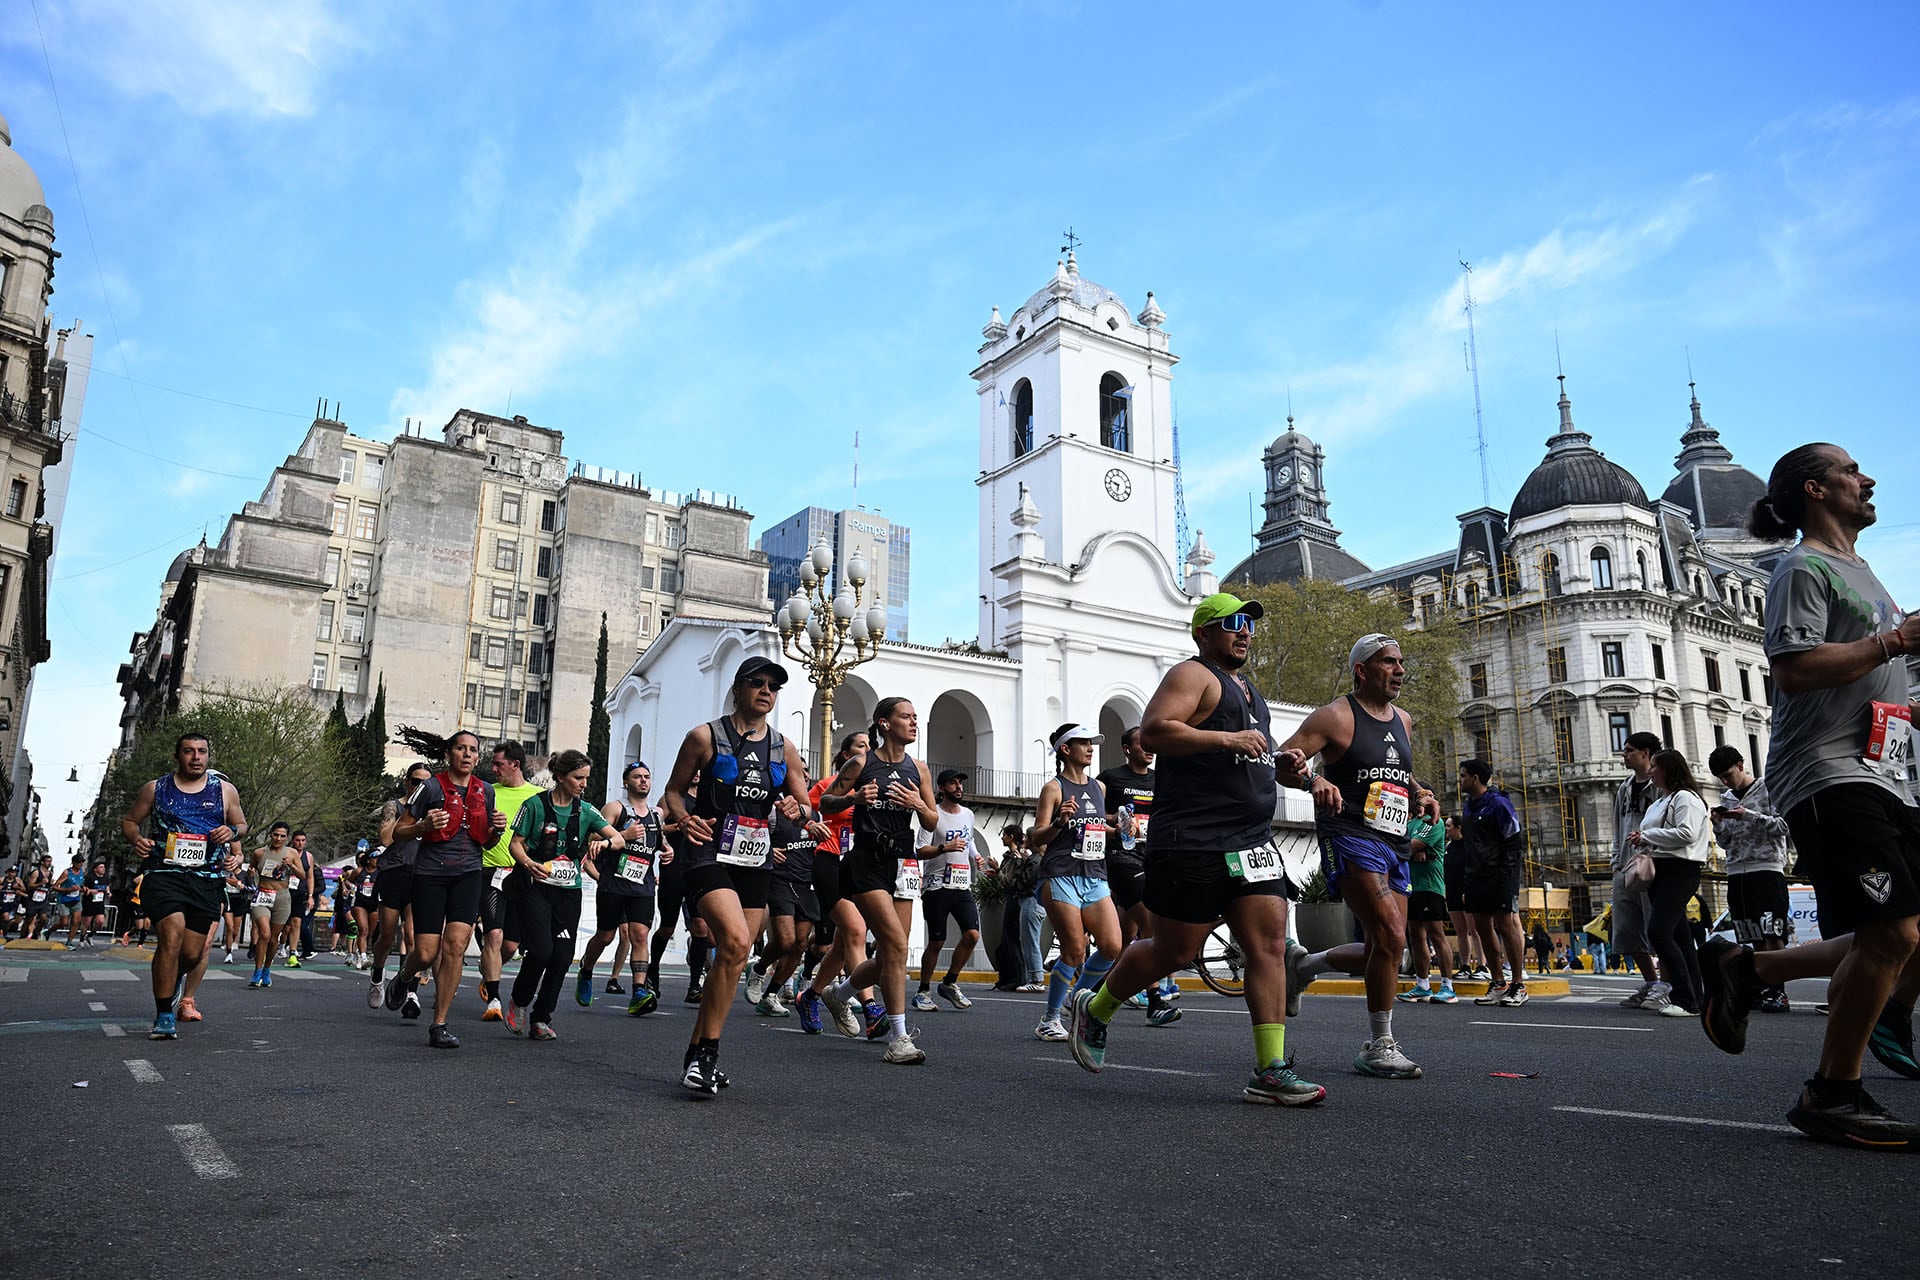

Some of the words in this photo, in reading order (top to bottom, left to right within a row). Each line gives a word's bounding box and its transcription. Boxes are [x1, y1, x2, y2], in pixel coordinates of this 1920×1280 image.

[852, 519, 887, 537] Pampa
[1878, 708, 1884, 723] C
[1381, 805, 1407, 825] 13737
[728, 819, 735, 830] F
[738, 840, 766, 856] 9922
[1086, 841, 1103, 853] 9158
[177, 848, 204, 860] 12280
[626, 868, 643, 879] 7753
